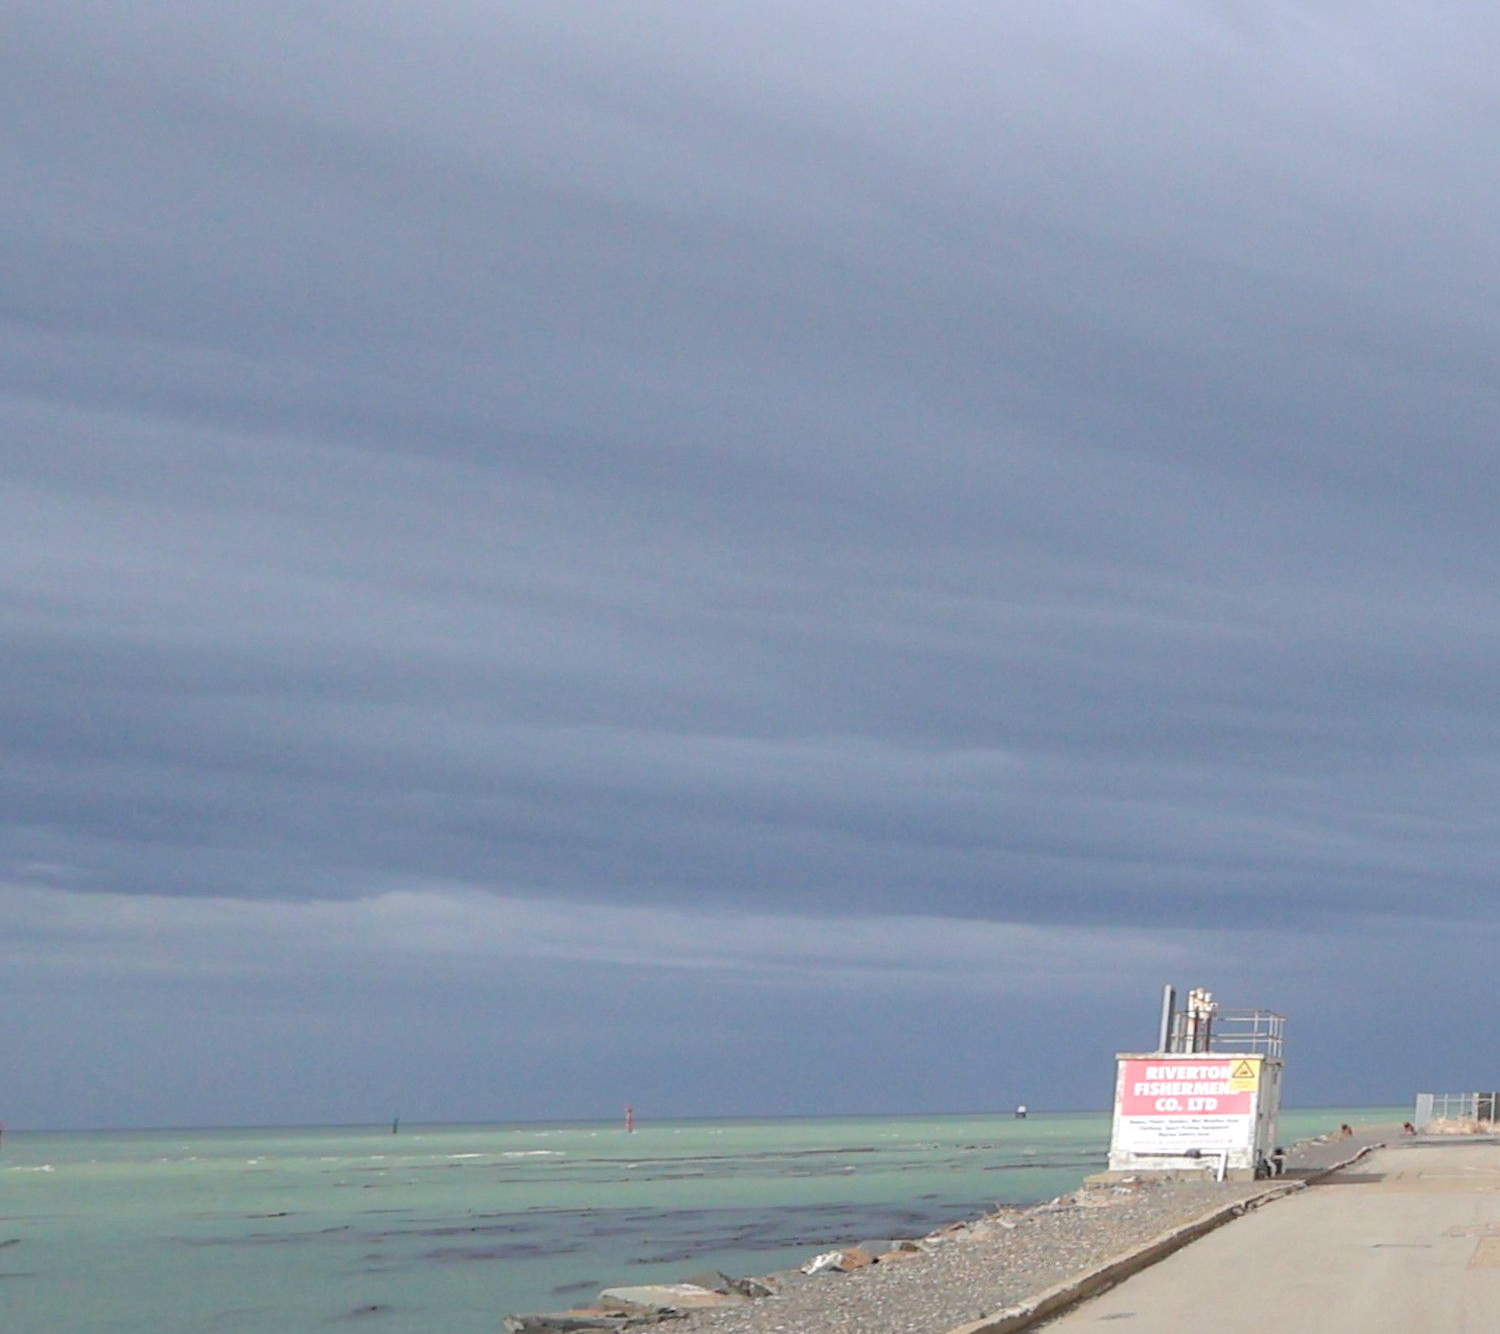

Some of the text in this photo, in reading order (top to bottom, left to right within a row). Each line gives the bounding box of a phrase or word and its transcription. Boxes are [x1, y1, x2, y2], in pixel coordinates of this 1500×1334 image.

[1145, 1066, 1232, 1080] RIVERTON
[1154, 1098, 1218, 1111] CO. LTD
